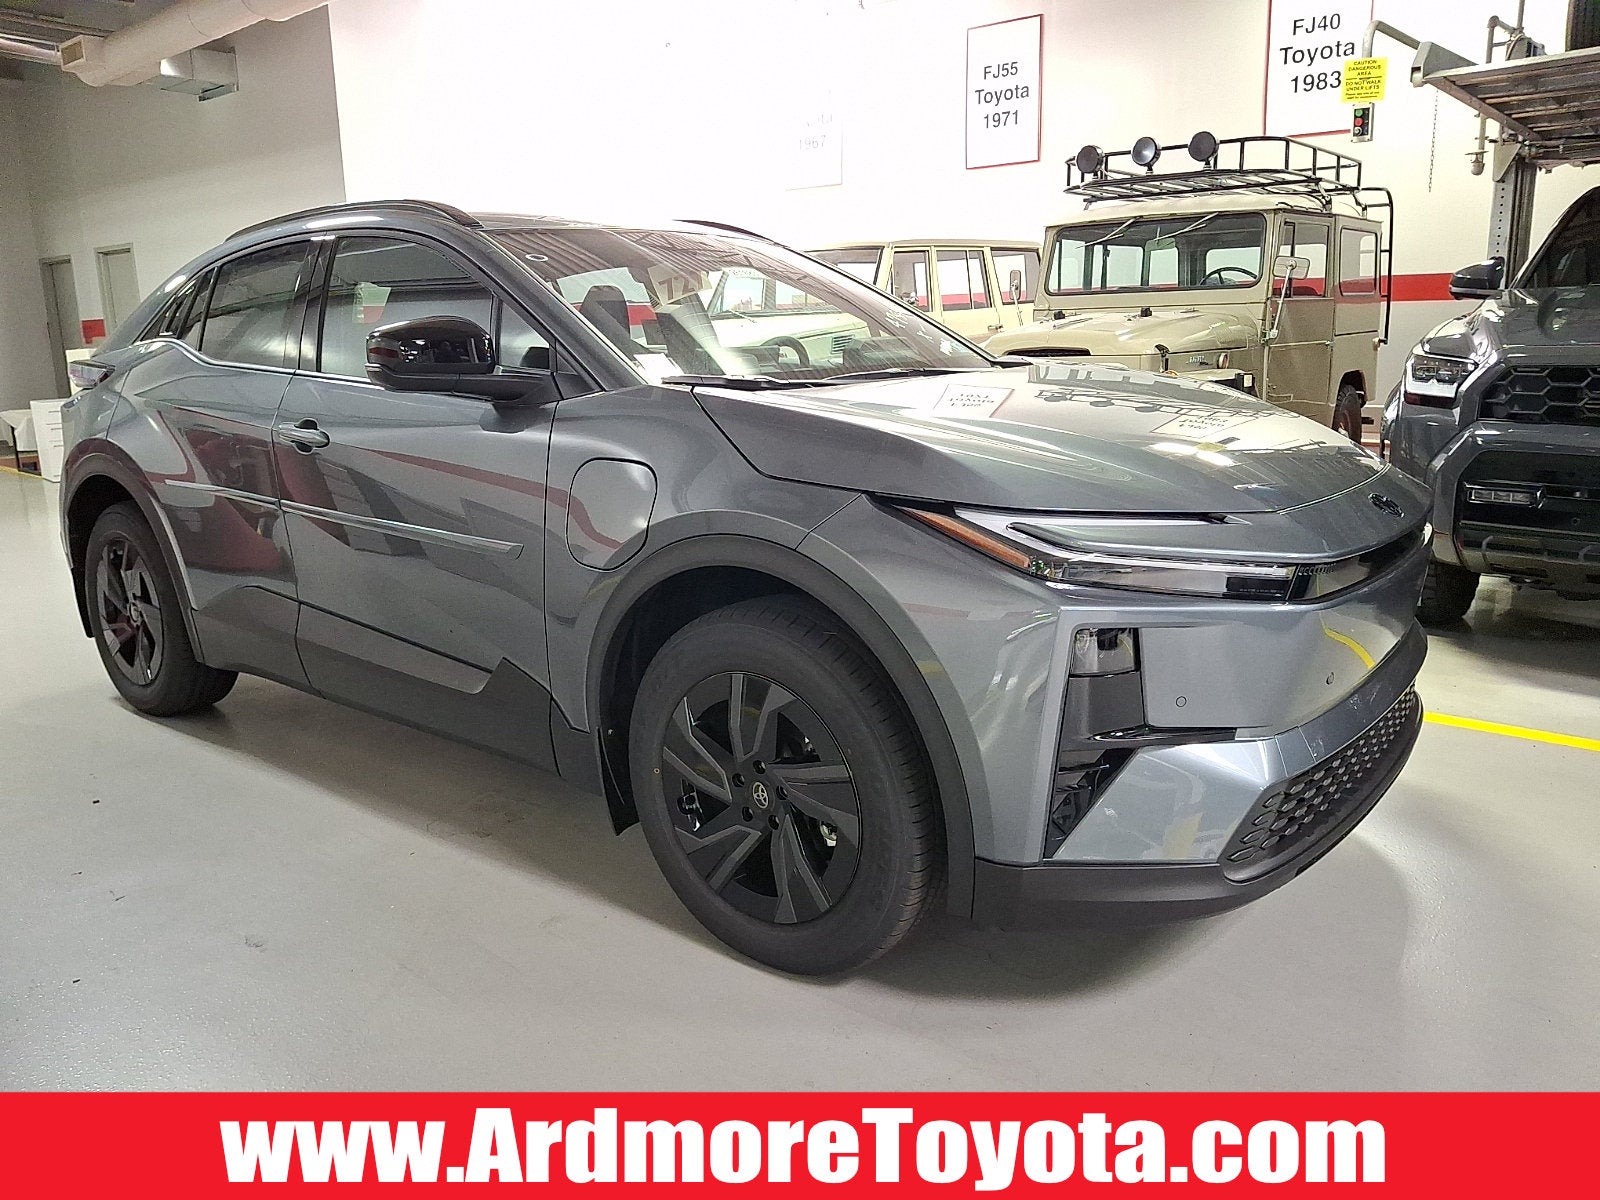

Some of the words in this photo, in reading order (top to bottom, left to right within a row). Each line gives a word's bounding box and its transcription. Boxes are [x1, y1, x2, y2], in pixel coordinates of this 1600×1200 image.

[1293, 13, 1341, 36] FJ40
[1280, 41, 1355, 67] Toyota
[983, 61, 1019, 80] FJ55
[1291, 70, 1342, 94] 1983
[974, 84, 1030, 107] Toyota
[983, 109, 1019, 129] 1971
